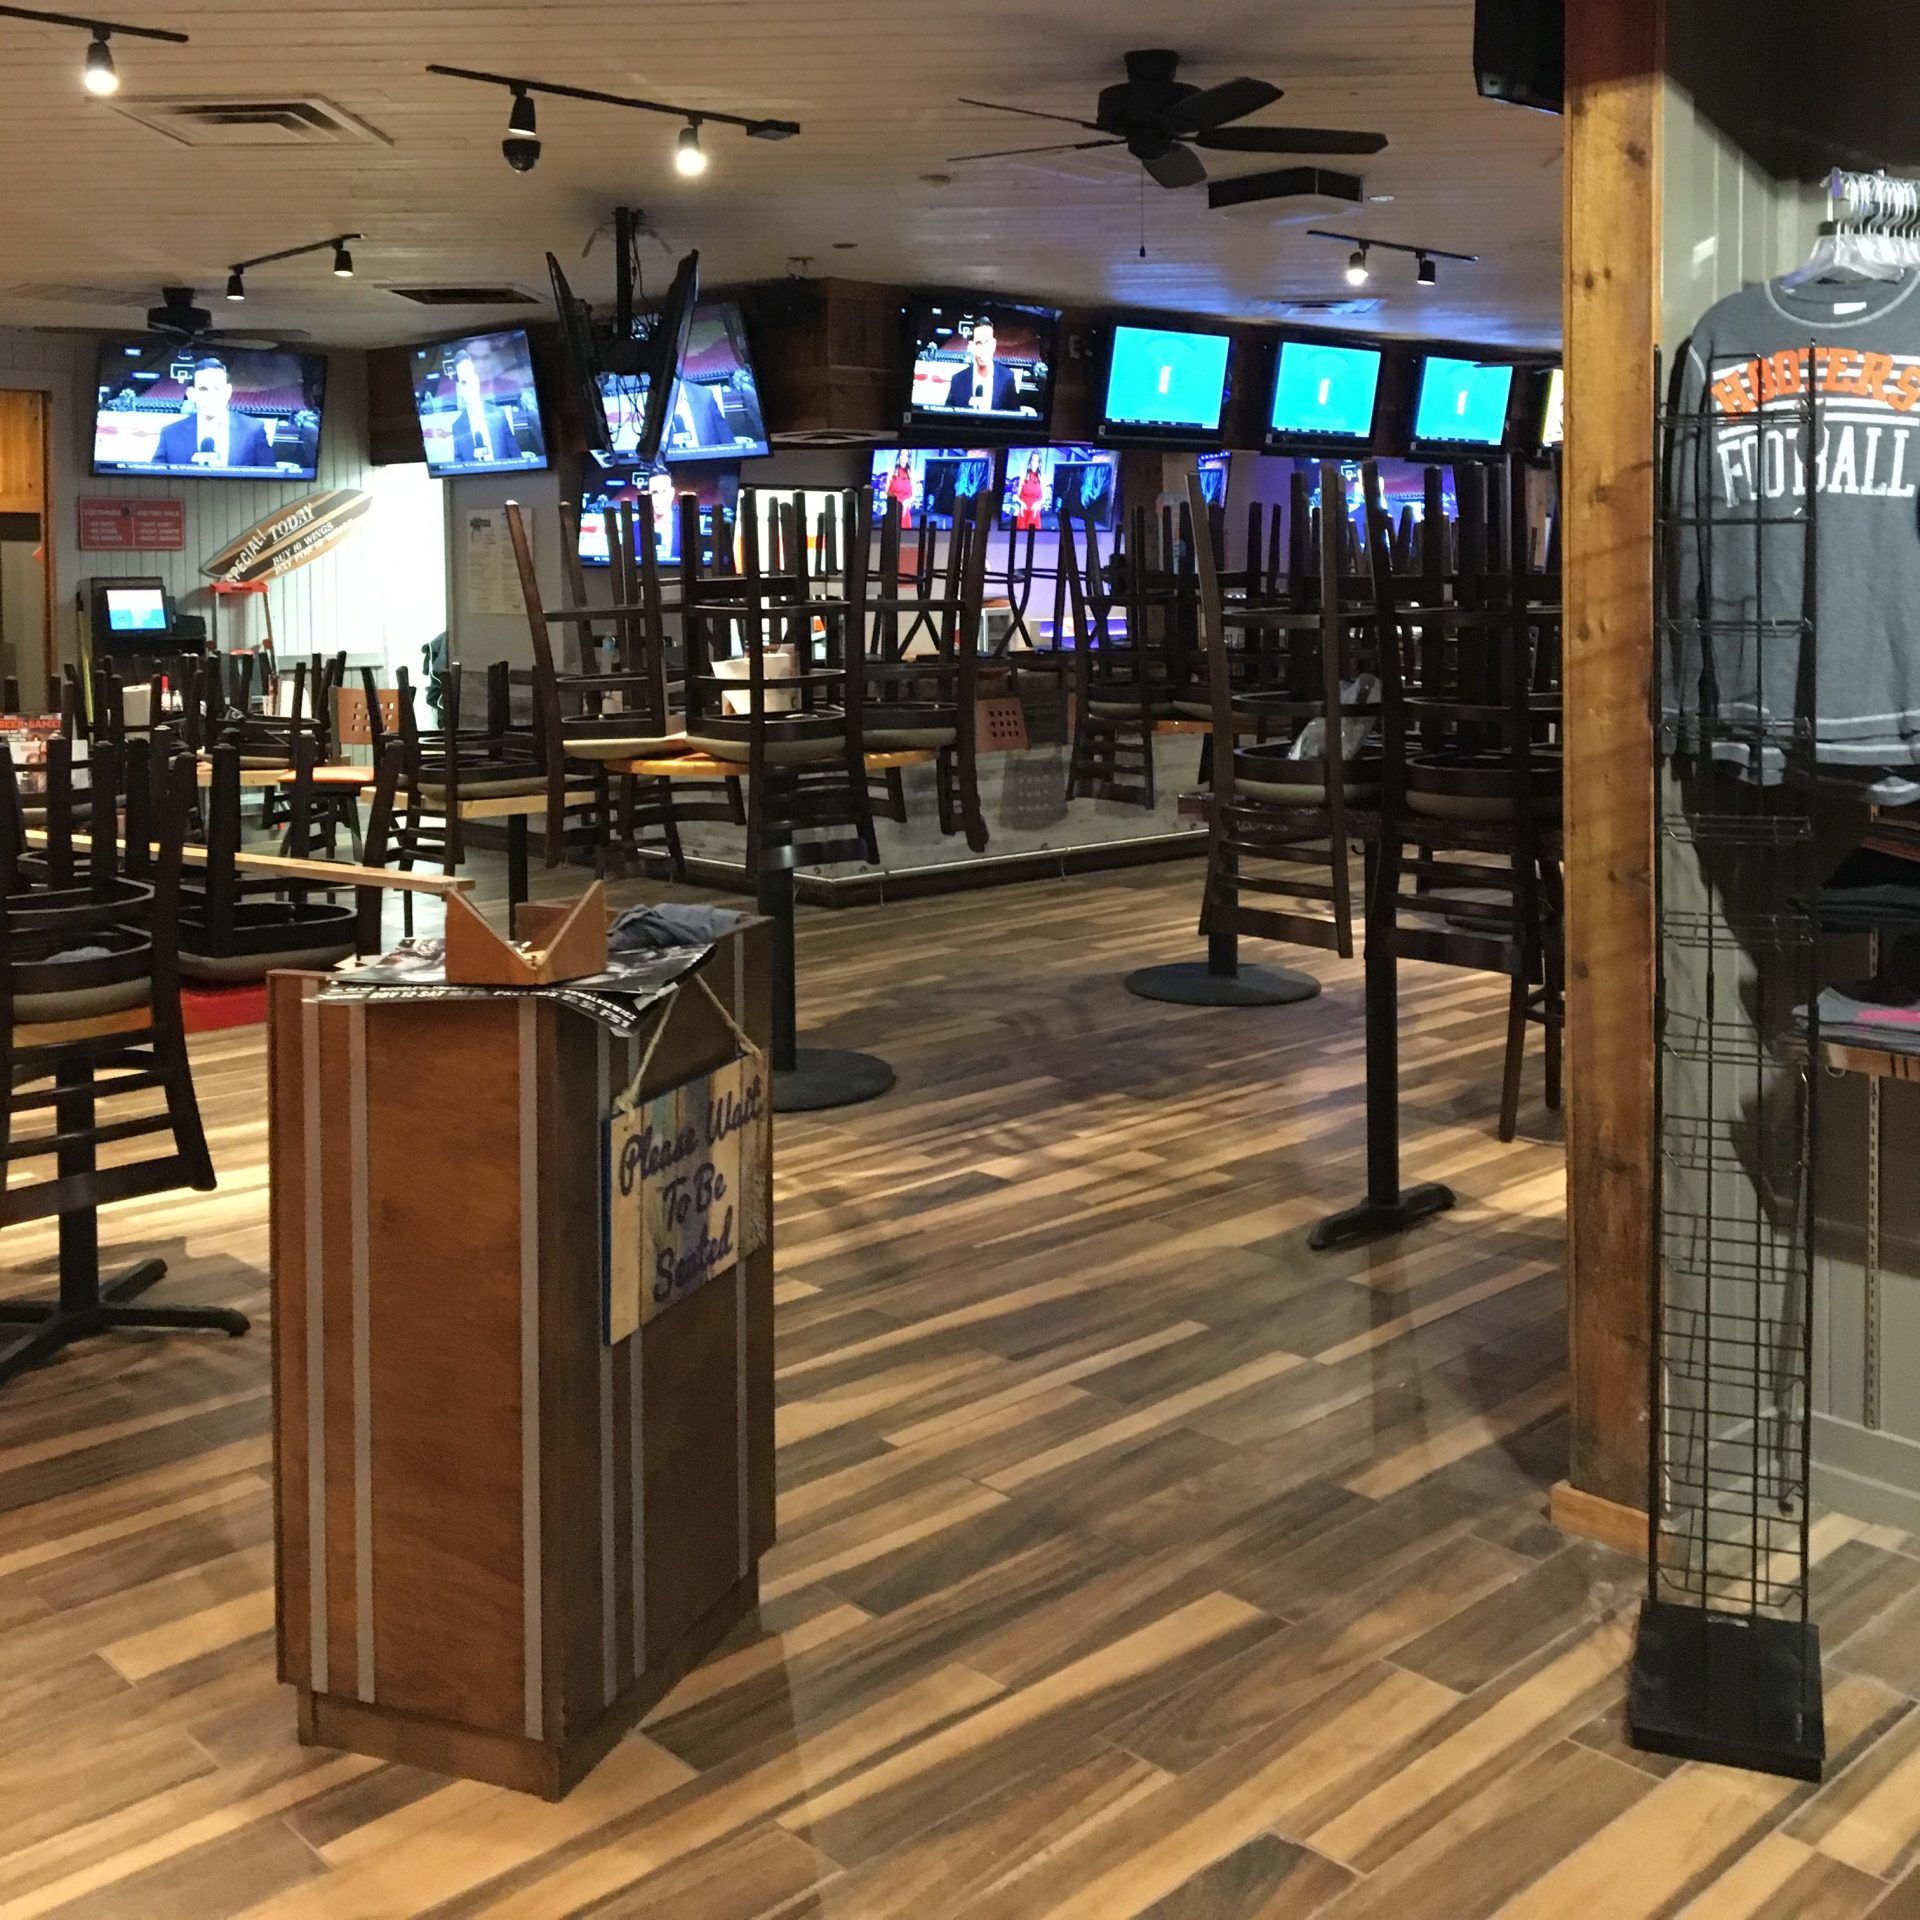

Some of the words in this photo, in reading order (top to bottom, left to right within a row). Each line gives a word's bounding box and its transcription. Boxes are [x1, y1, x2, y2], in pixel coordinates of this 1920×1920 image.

[268, 502, 315, 542] TODAY
[272, 548, 291, 567] BUY
[303, 521, 334, 546] WINGS
[619, 1123, 698, 1197] Please
[705, 1073, 763, 1147] Wait
[661, 1175, 692, 1232] To
[693, 1161, 727, 1213] Be
[652, 1204, 734, 1303] Seated
